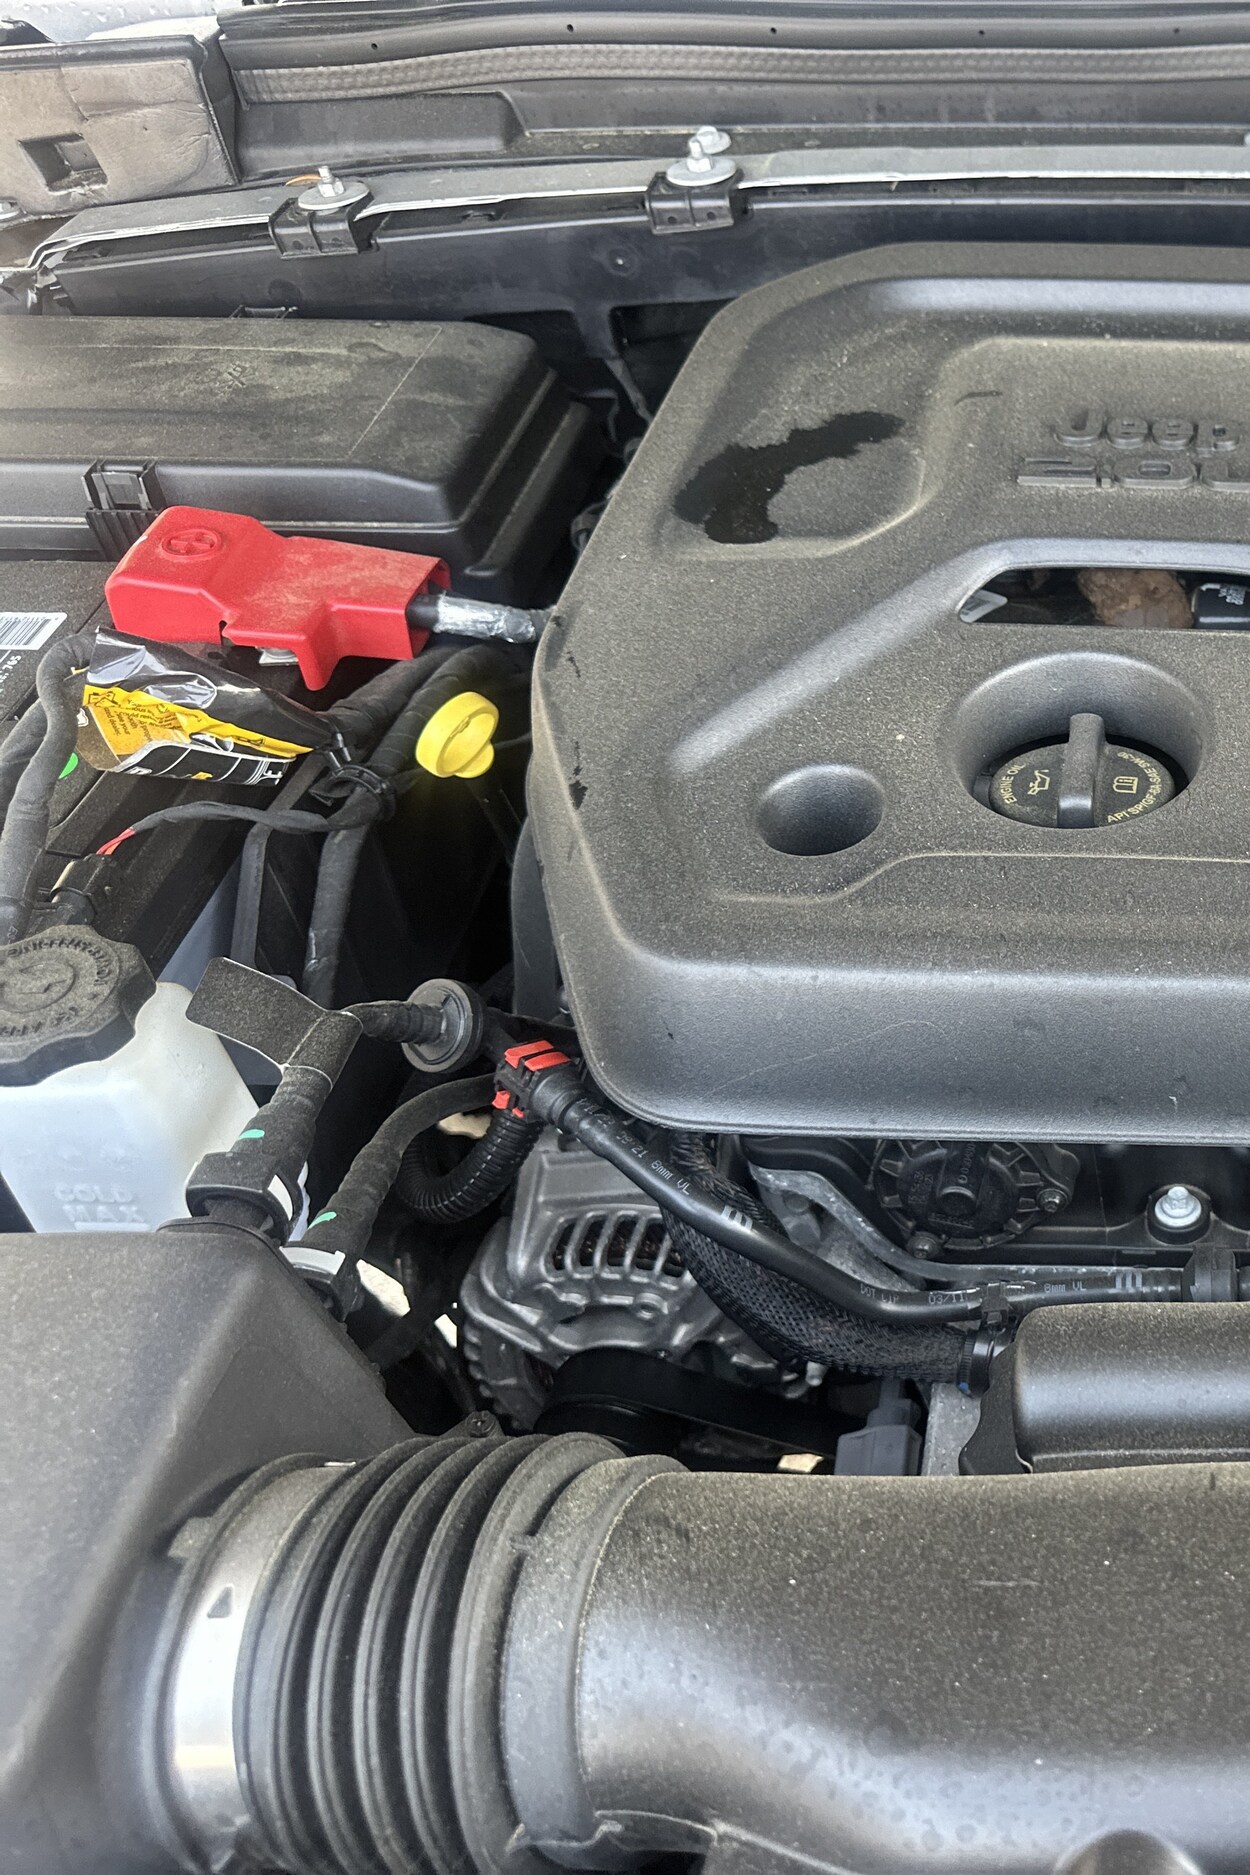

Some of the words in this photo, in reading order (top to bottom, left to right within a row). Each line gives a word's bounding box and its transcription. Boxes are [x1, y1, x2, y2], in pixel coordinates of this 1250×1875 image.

[1054, 408, 1241, 458] Jeep
[1008, 762, 1026, 776] OIL
[1000, 775, 1017, 804] ENGINE
[54, 1183, 133, 1203] COLD
[62, 1204, 145, 1223] MAX
